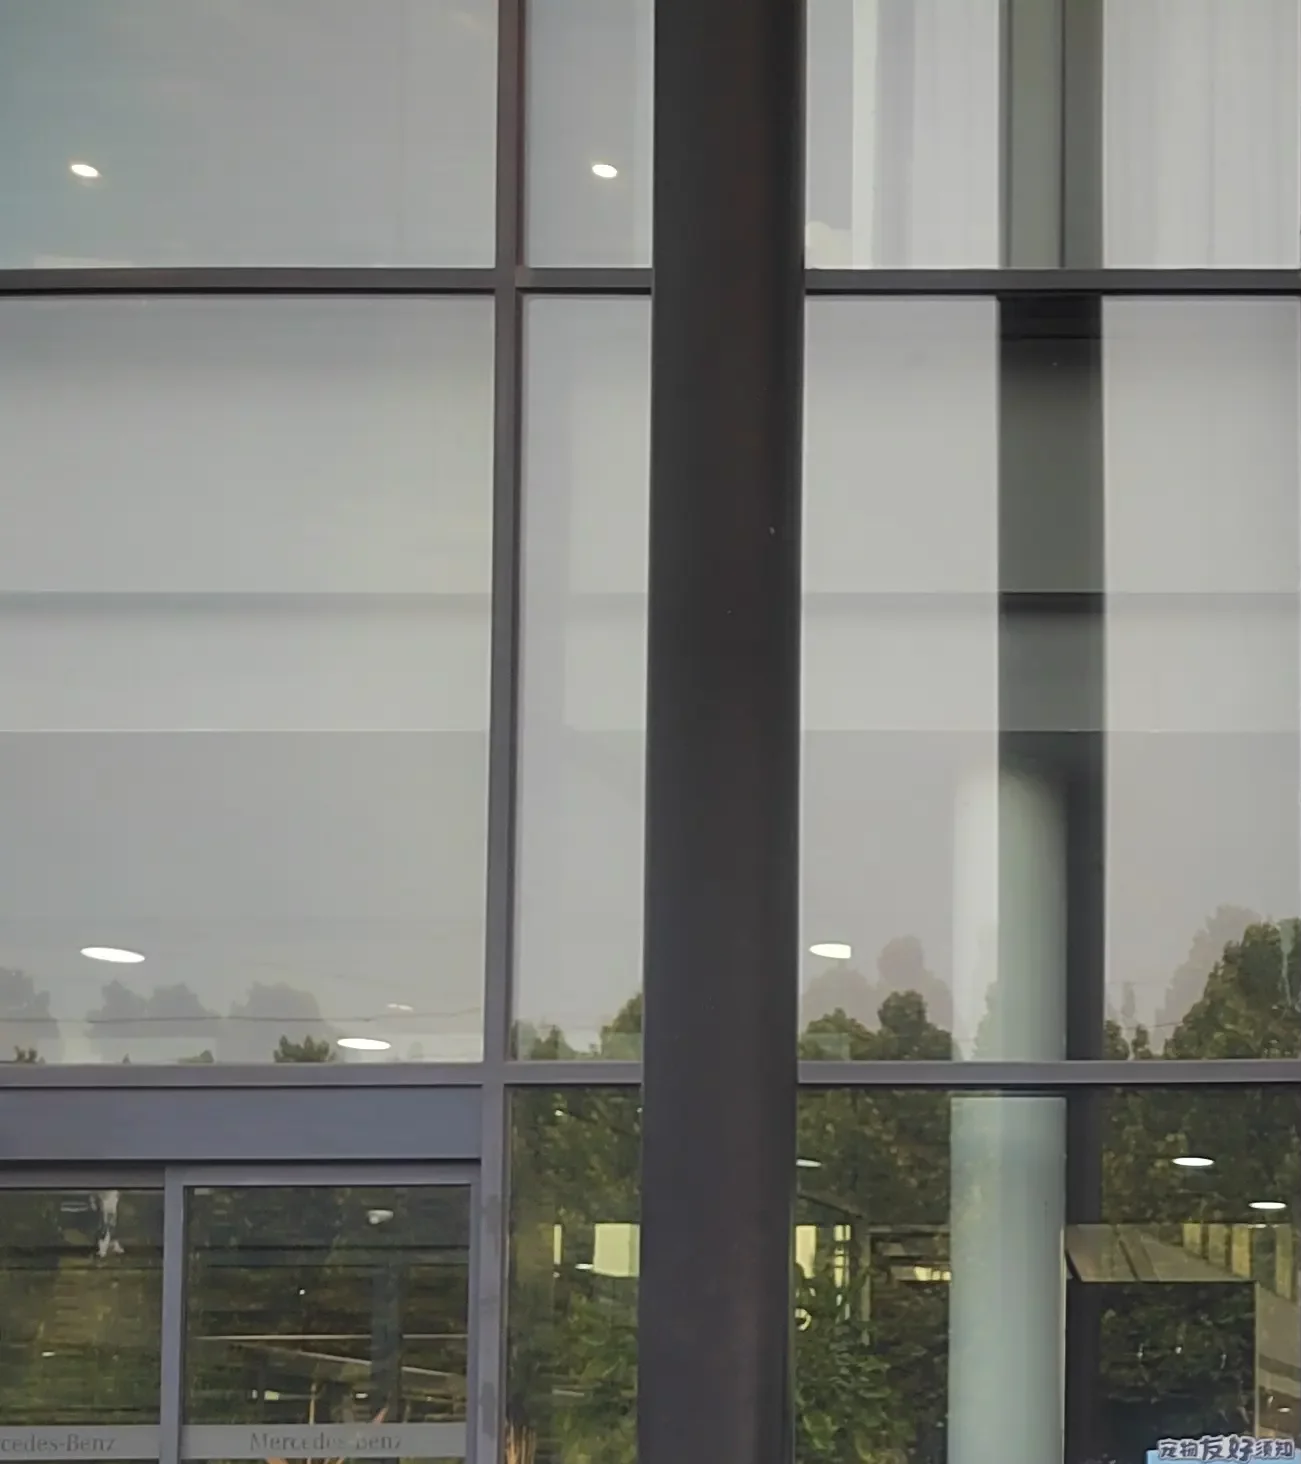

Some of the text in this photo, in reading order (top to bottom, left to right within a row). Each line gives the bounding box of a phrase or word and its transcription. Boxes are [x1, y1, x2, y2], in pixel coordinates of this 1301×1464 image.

[0, 1433, 116, 1452] cedes-Benz
[250, 1431, 401, 1451] MercedesBenz
[1159, 1436, 1294, 1462] 宠物友好须知
